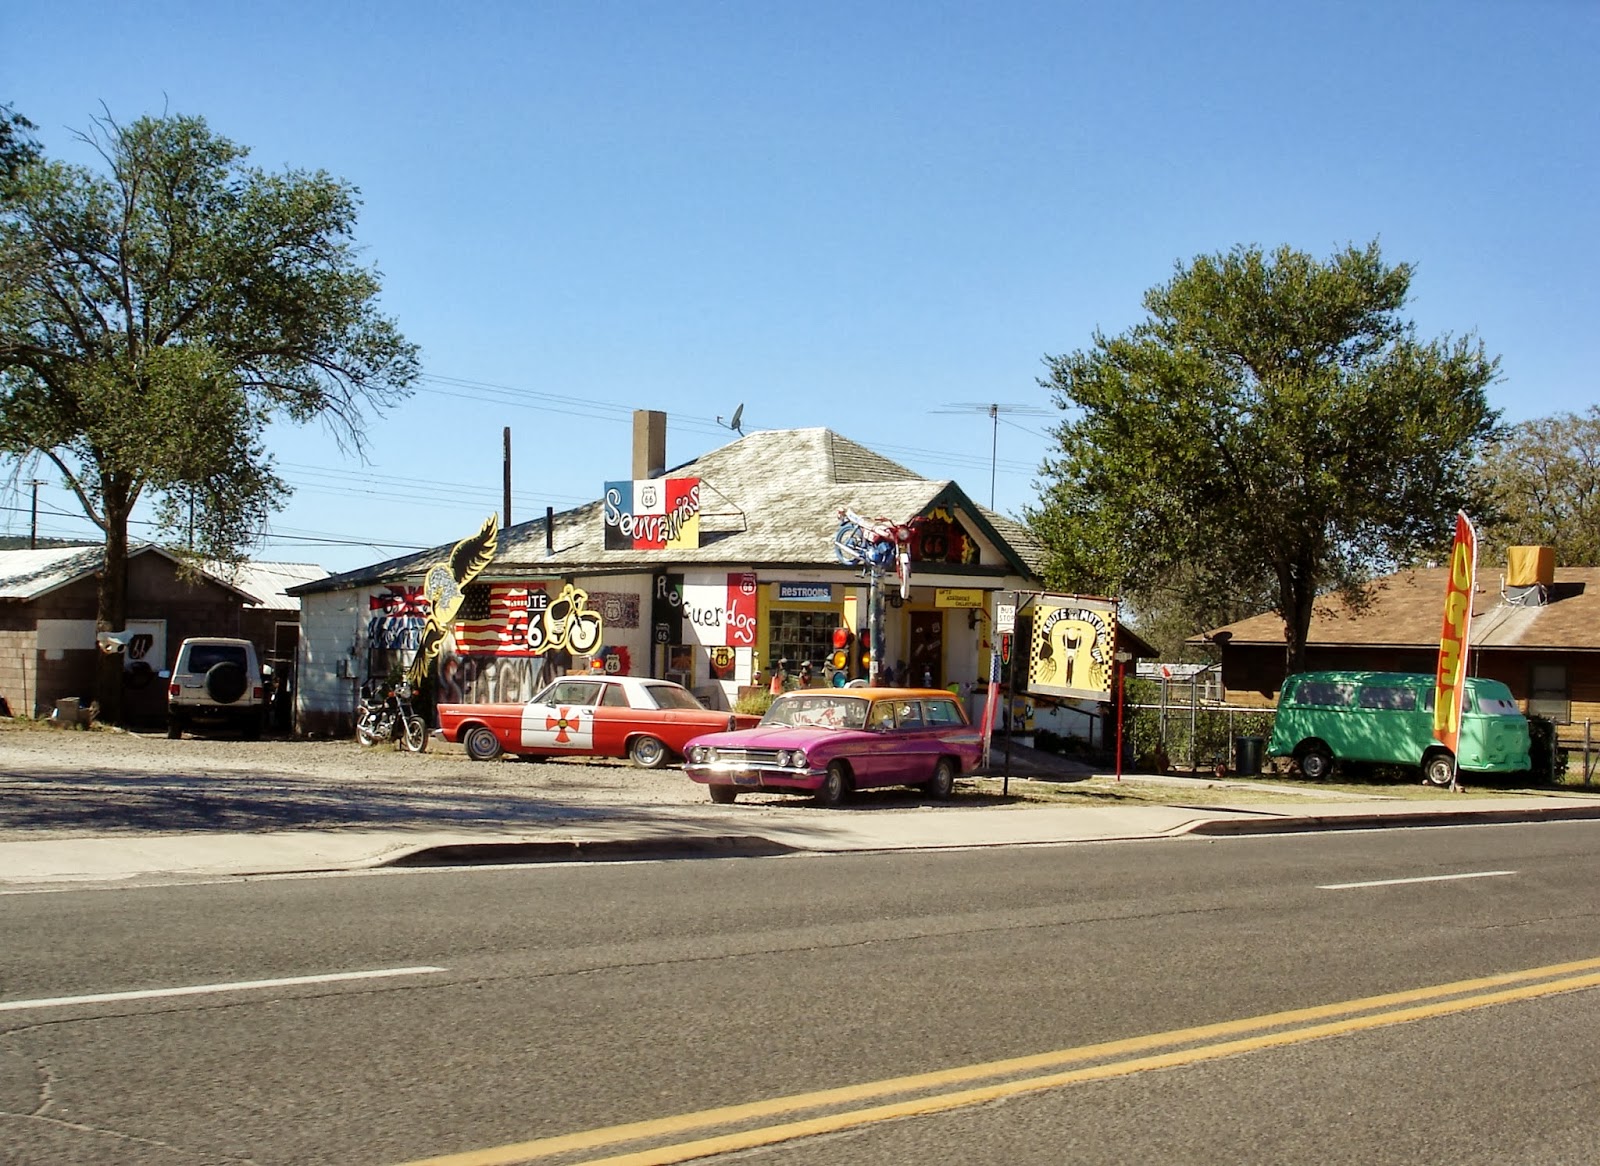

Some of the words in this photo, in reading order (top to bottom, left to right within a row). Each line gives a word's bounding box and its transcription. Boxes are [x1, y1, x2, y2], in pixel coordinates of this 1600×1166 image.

[742, 582, 753, 592] 66
[1000, 606, 1014, 614] BUS
[999, 614, 1014, 622] STOP
[1042, 608, 1068, 634] ROUTE
[512, 613, 543, 647] 66
[657, 631, 668, 641] 66
[717, 655, 728, 665] 66
[607, 661, 618, 671] 66
